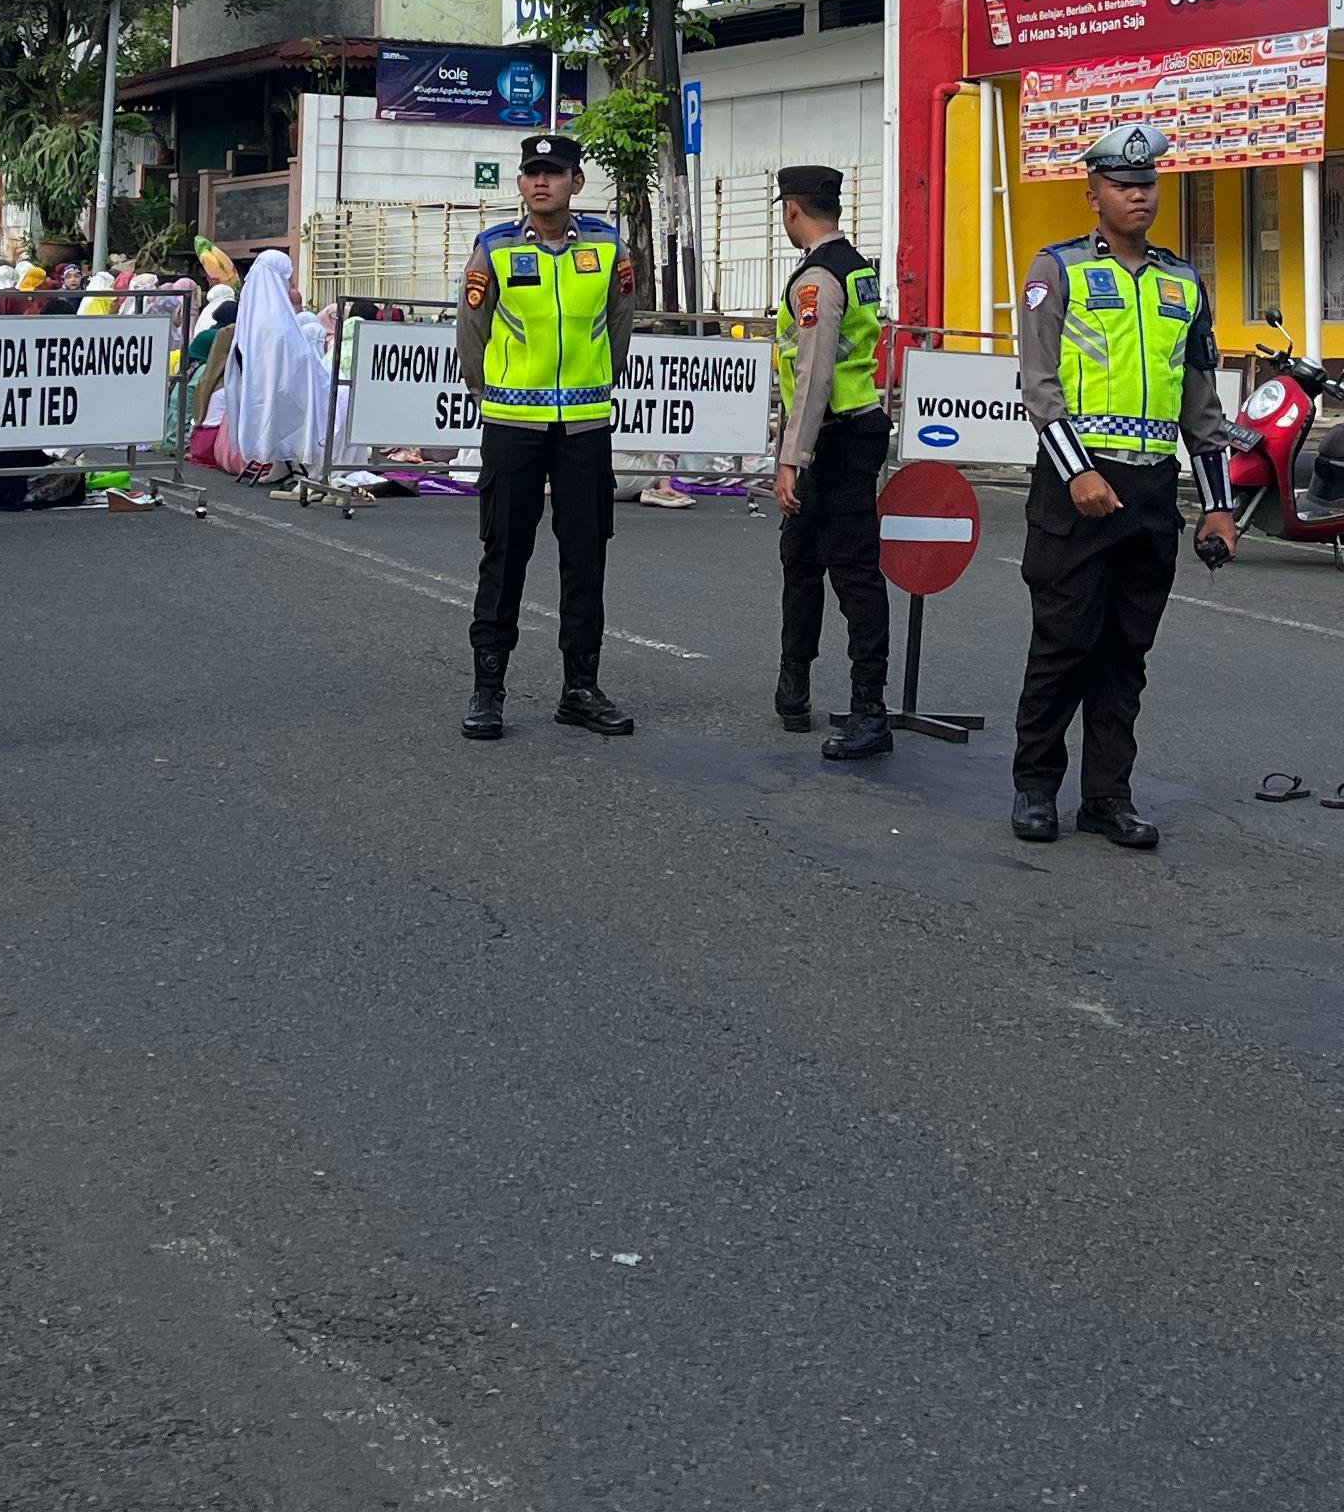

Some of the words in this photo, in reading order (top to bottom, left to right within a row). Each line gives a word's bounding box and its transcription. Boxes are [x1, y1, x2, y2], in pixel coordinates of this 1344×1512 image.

[1016, 11, 1038, 25] Untuk
[1097, 1, 1104, 12] &
[1017, 31, 1028, 44] di
[1029, 26, 1056, 42] Mana
[1057, 22, 1078, 40] Saja
[1079, 22, 1087, 35] &
[1089, 16, 1122, 35] Kapan
[1123, 12, 1146, 30] Saja
[438, 66, 469, 81] bale
[1164, 53, 1188, 72] Lolos
[1189, 50, 1223, 71] SNBP
[1224, 47, 1253, 65] 2025
[687, 89, 699, 145] P
[35, 335, 154, 378] TERGANGGU
[370, 344, 440, 384] MOHON
[660, 355, 757, 394] TERGANGGU
[38, 385, 79, 427] IED
[661, 399, 695, 435] IED
[917, 396, 1030, 423] WONOGIR
